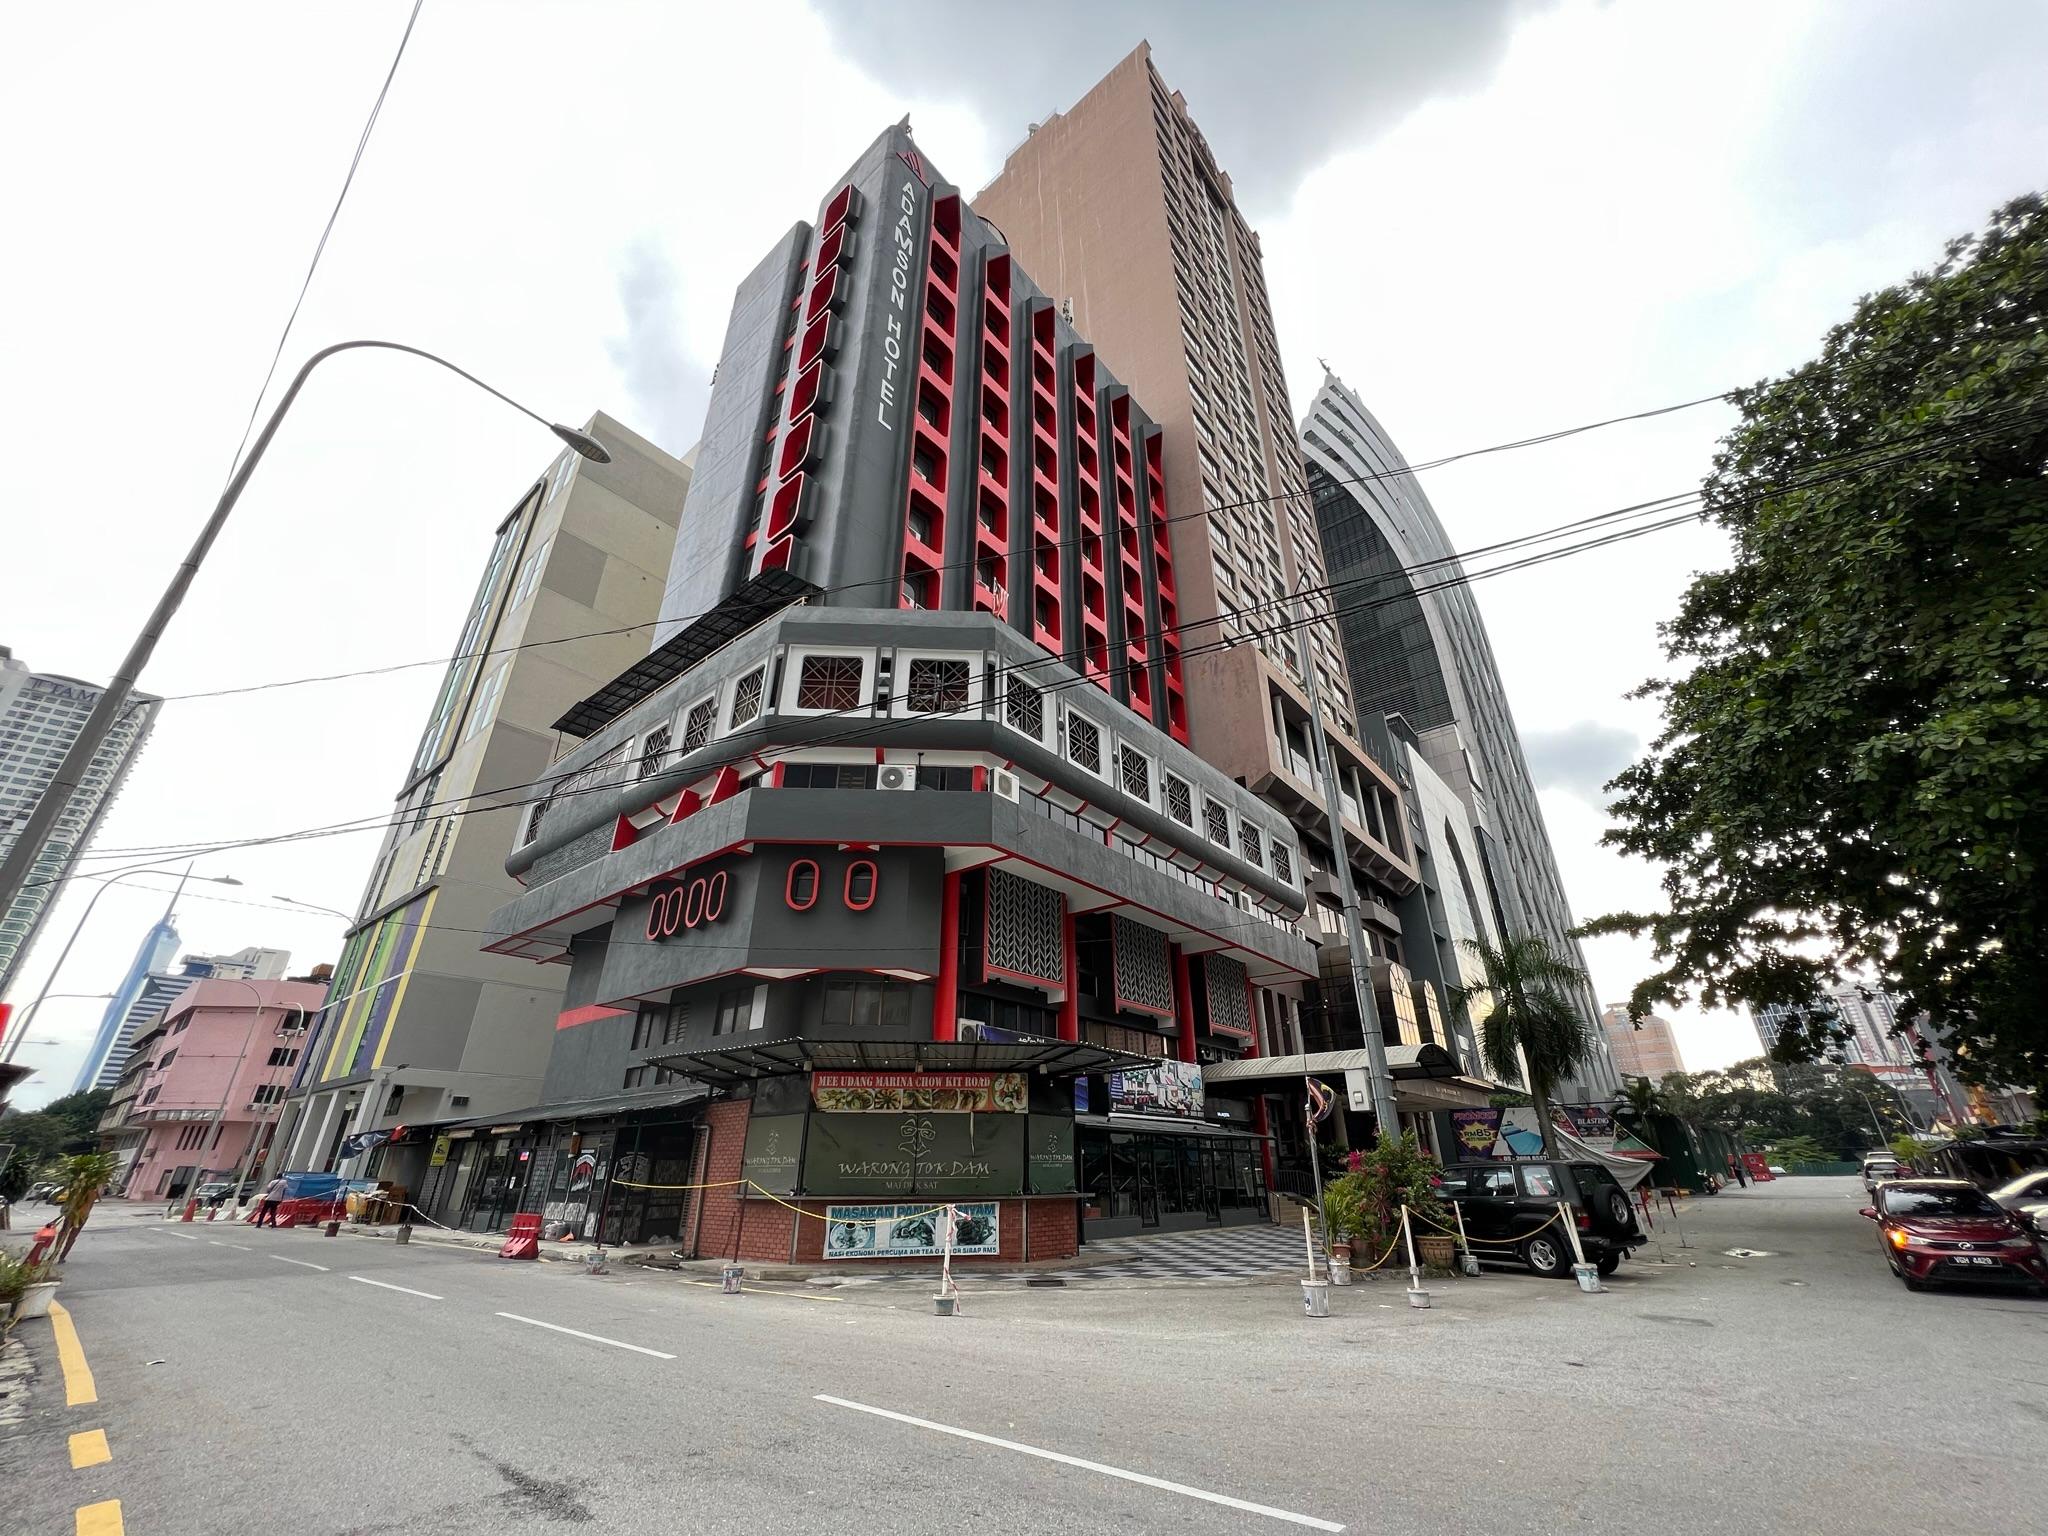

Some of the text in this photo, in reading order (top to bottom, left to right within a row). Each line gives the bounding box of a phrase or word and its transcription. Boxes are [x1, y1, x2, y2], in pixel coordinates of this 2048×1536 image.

[877, 181, 916, 431] ADAMSON HOTEL
[818, 1076, 991, 1088] MEE UDANG MARINA CHOW KIT ROAD
[838, 1161, 911, 1179] WARONG
[950, 1160, 990, 1176] DAM
[830, 1205, 895, 1219] MASAKAN
